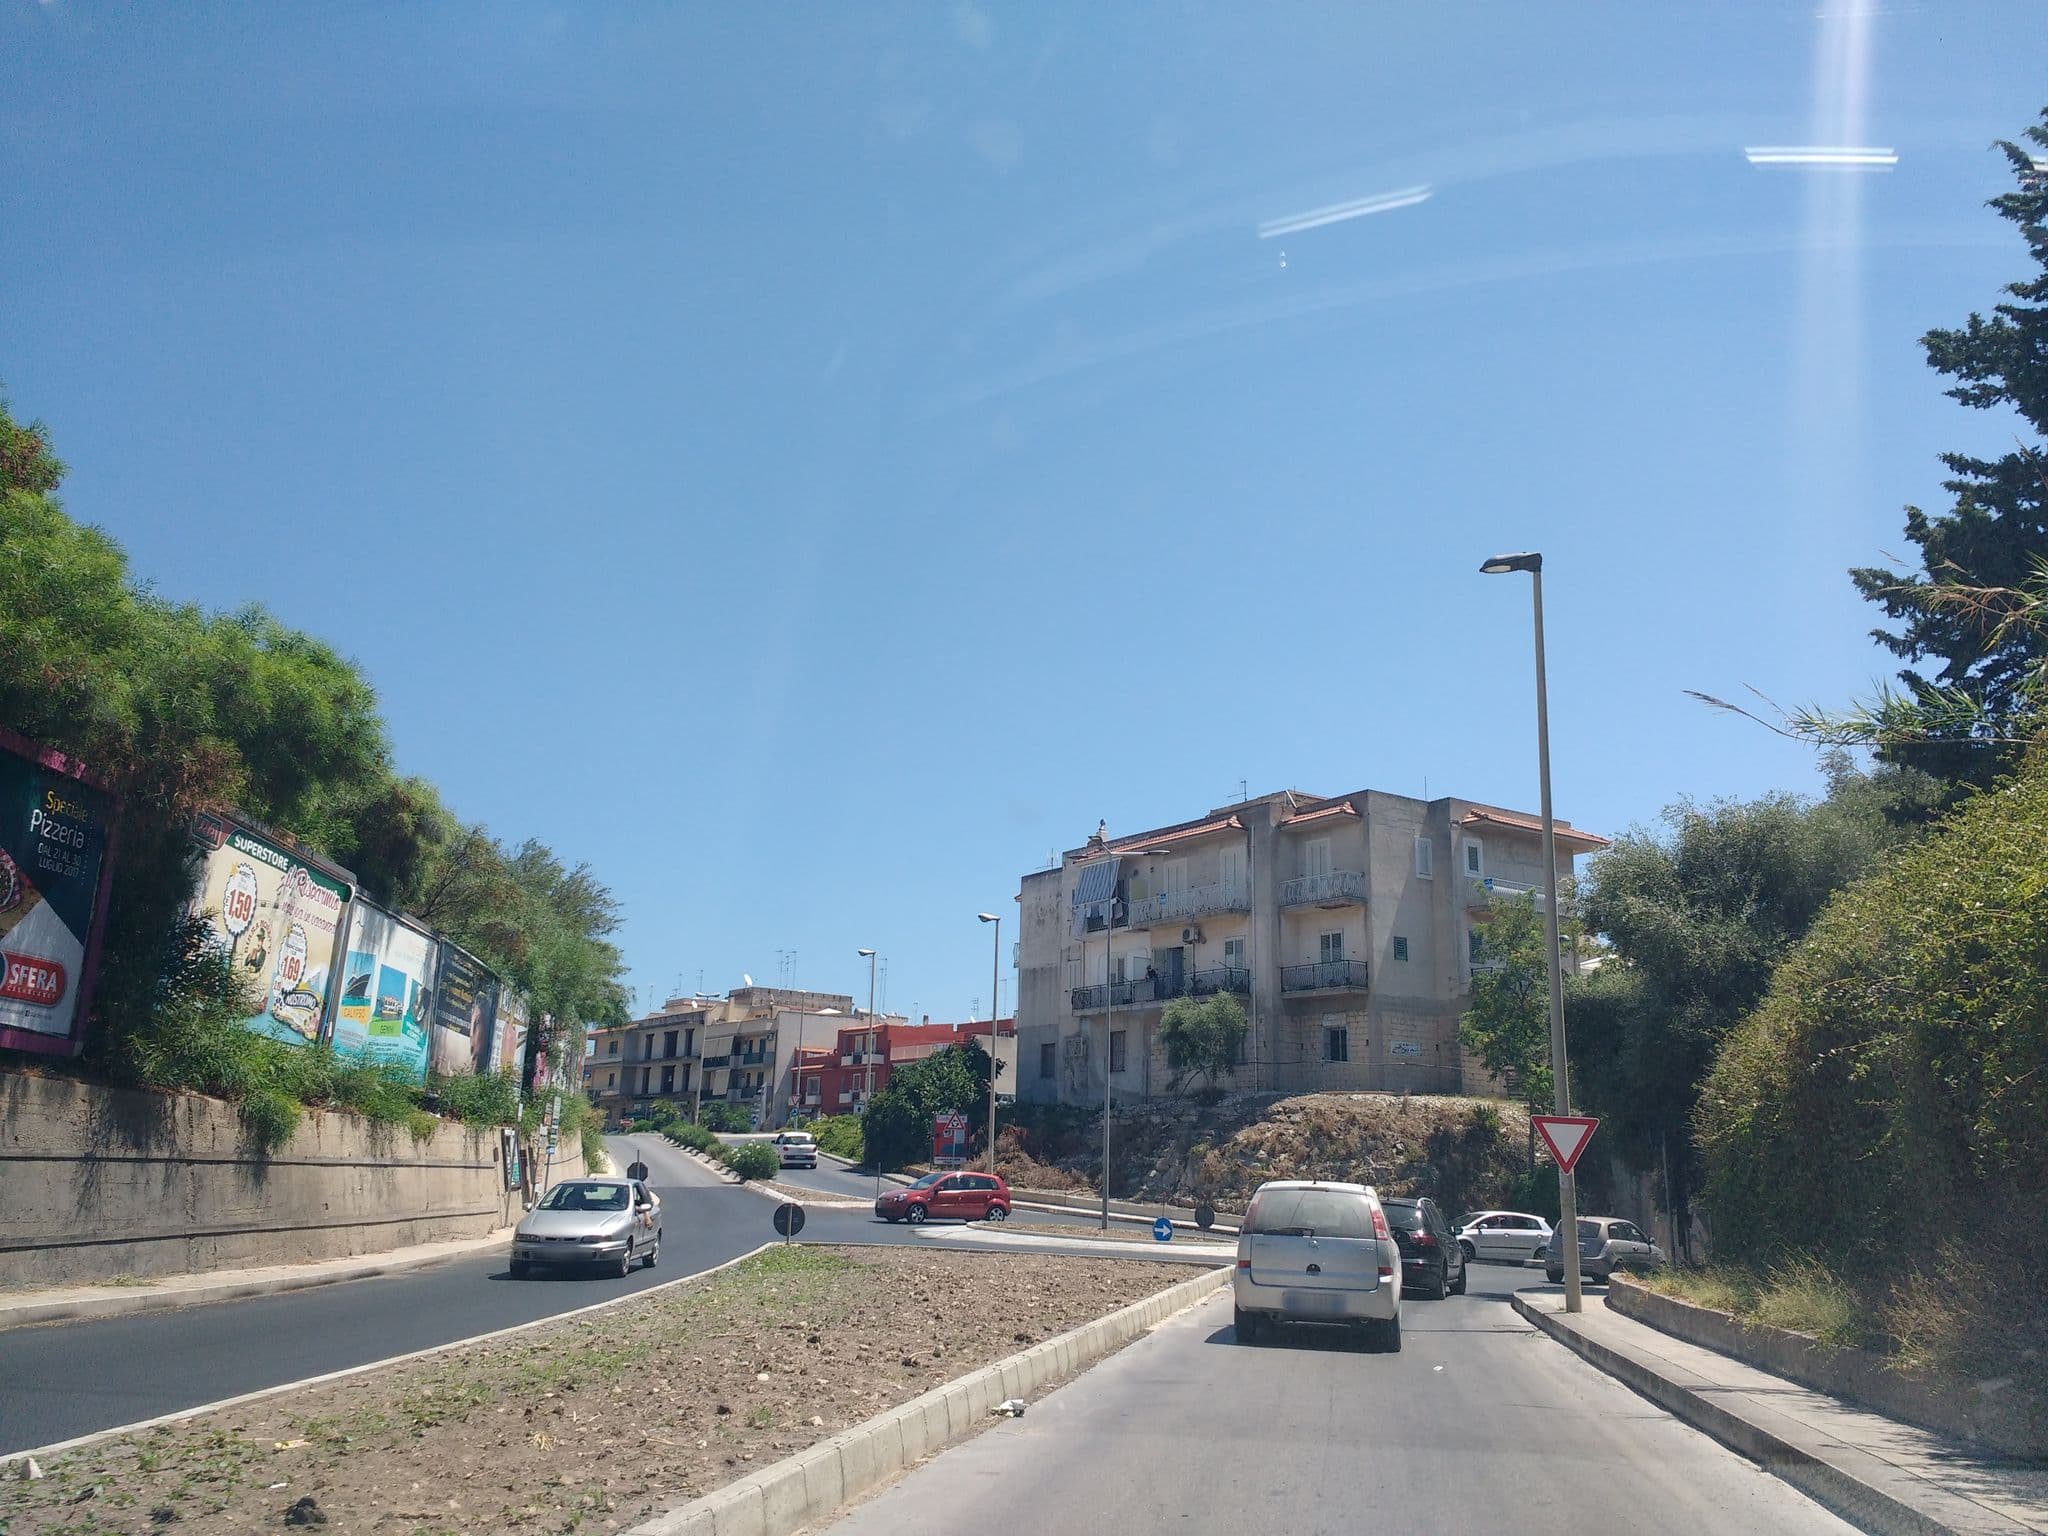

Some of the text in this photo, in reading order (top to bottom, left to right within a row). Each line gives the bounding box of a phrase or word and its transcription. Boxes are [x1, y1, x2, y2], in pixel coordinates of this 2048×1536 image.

[46, 790, 88, 822] Speciale
[30, 809, 85, 848] Pizzeria
[234, 834, 289, 871] SUPERSTORE
[9, 963, 57, 993] SFERA
